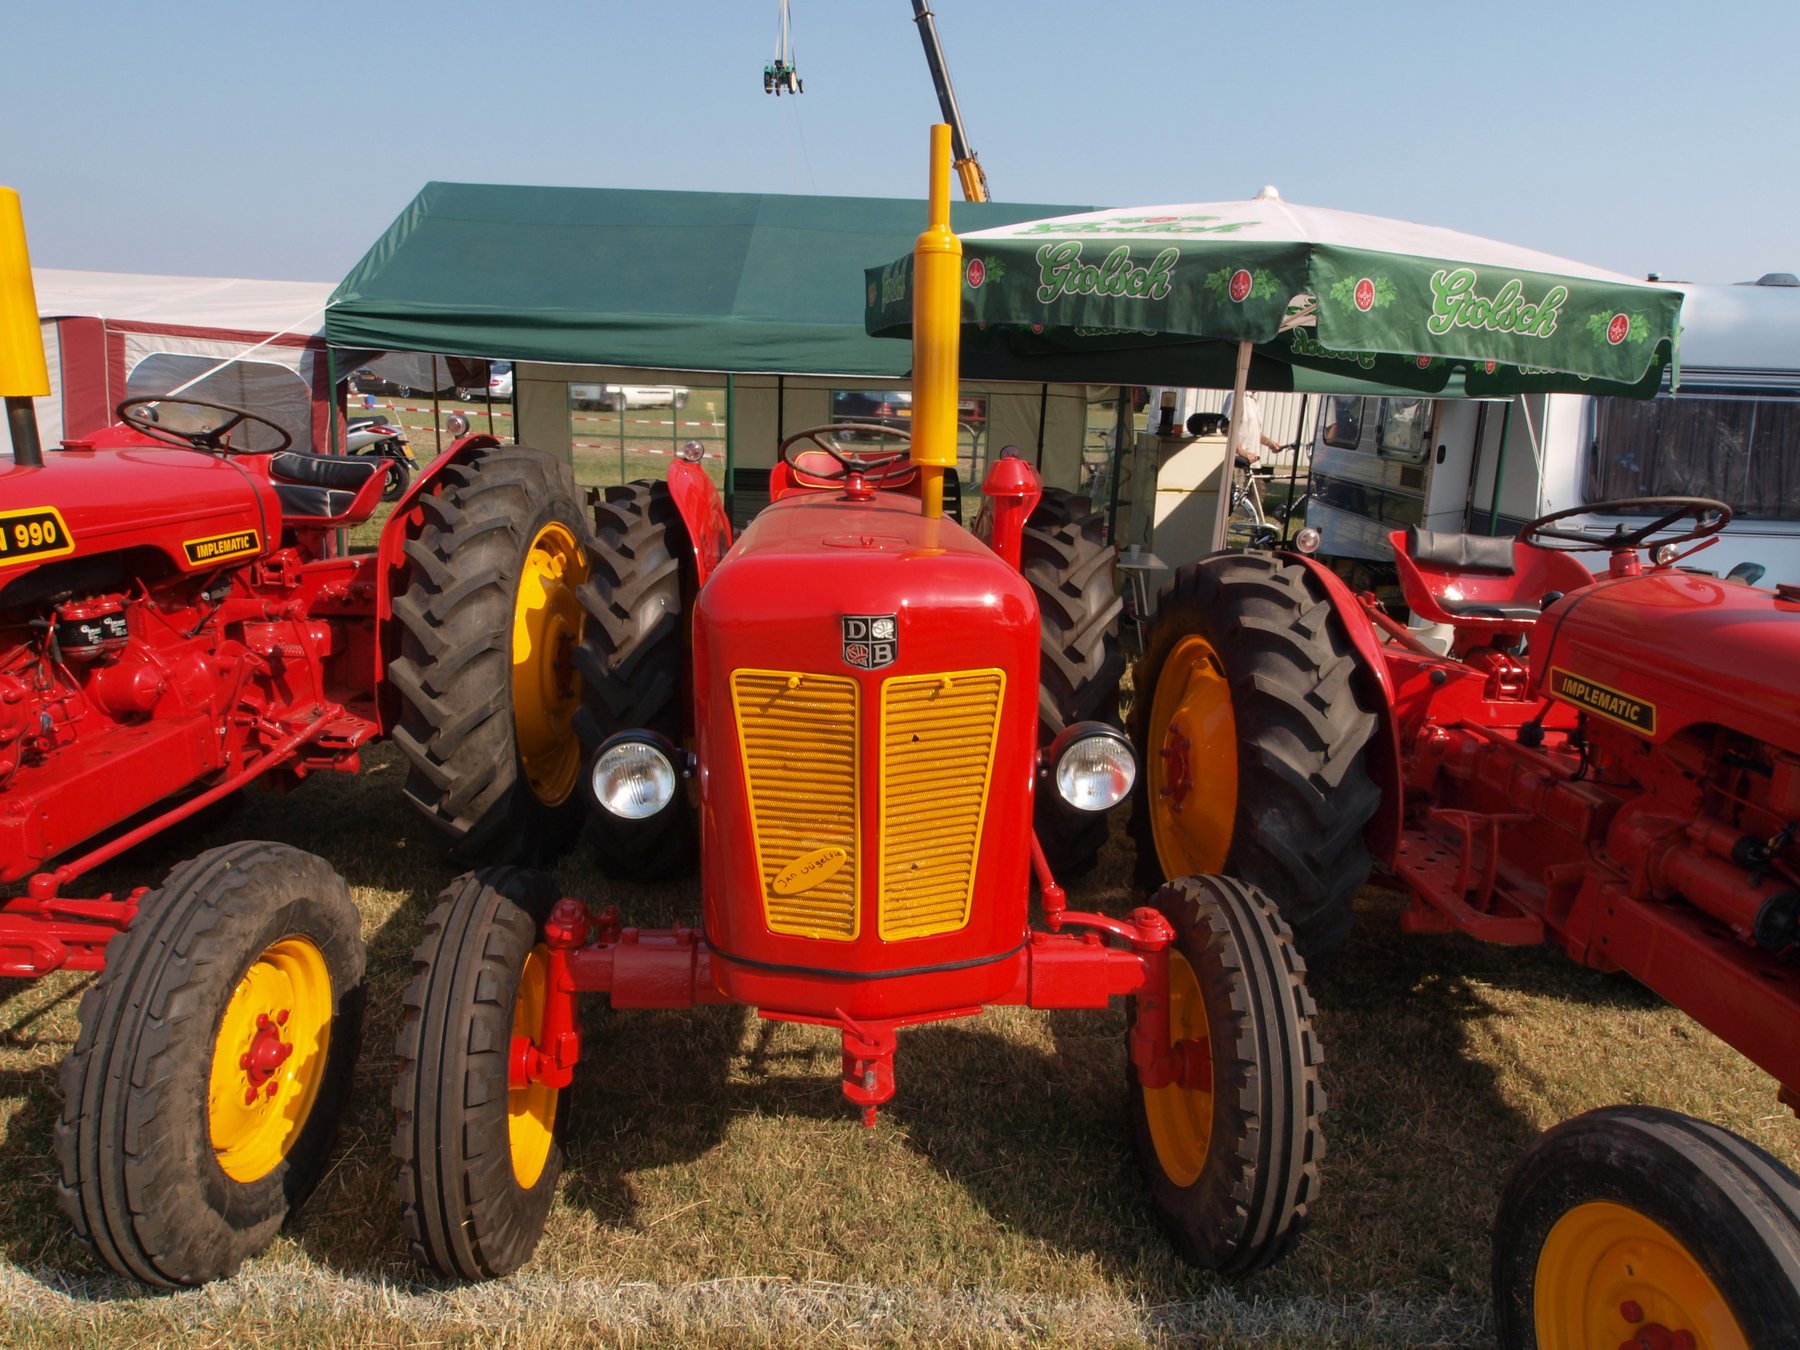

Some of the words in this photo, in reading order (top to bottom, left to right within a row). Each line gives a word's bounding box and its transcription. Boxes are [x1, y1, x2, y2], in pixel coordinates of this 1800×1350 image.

[1037, 241, 1179, 303] Grolsch
[1427, 268, 1568, 338] Grolsch
[15, 520, 56, 548] 990
[196, 535, 250, 559] IMPLEMATIC
[1562, 677, 1641, 721] IMPLEMATIC
